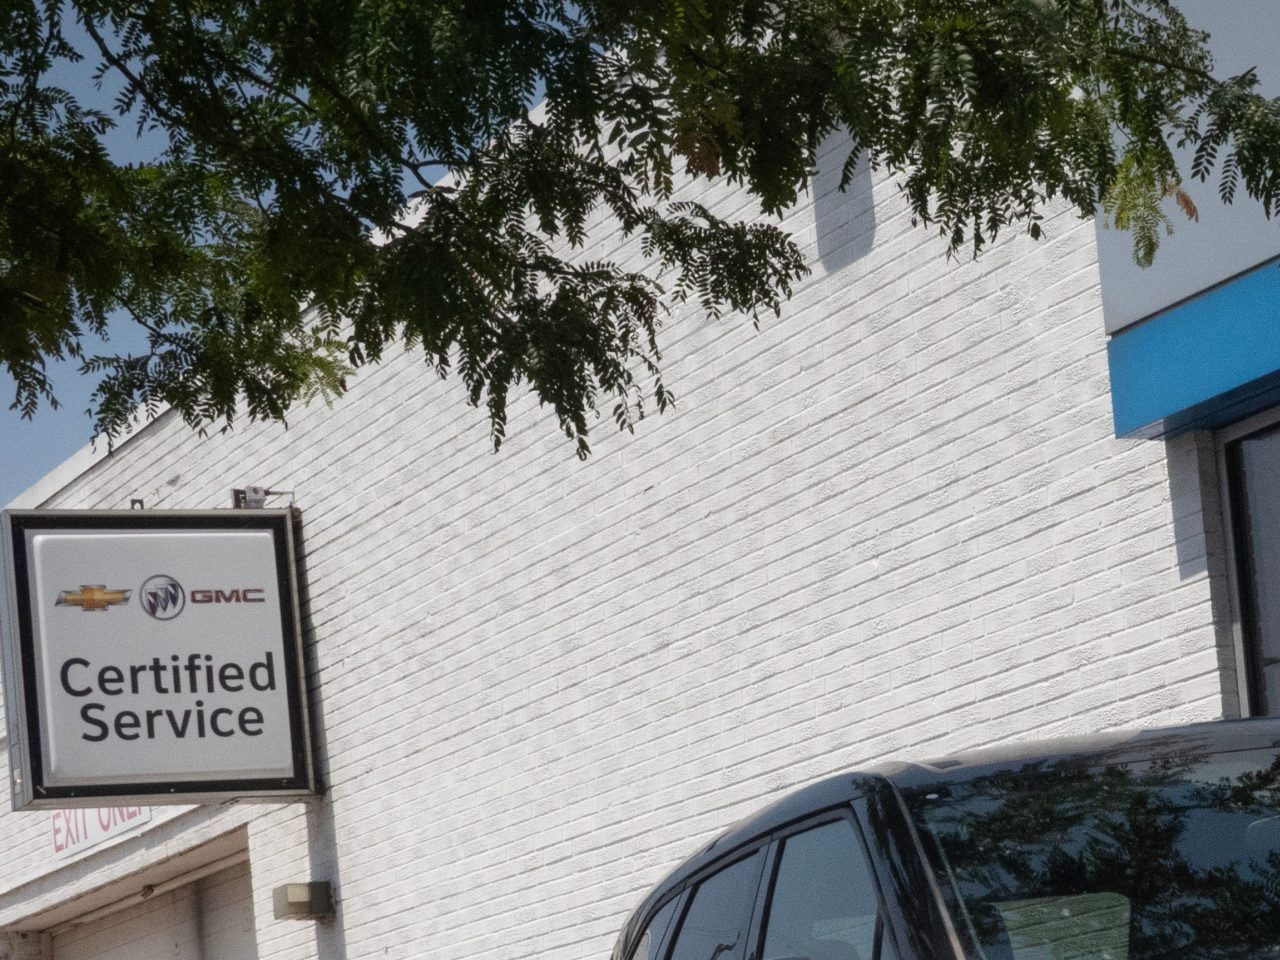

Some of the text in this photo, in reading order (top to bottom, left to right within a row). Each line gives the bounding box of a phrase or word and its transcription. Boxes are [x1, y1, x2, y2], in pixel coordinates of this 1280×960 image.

[190, 588, 266, 604] GMC
[60, 651, 277, 697] Certified
[79, 700, 265, 742] Service
